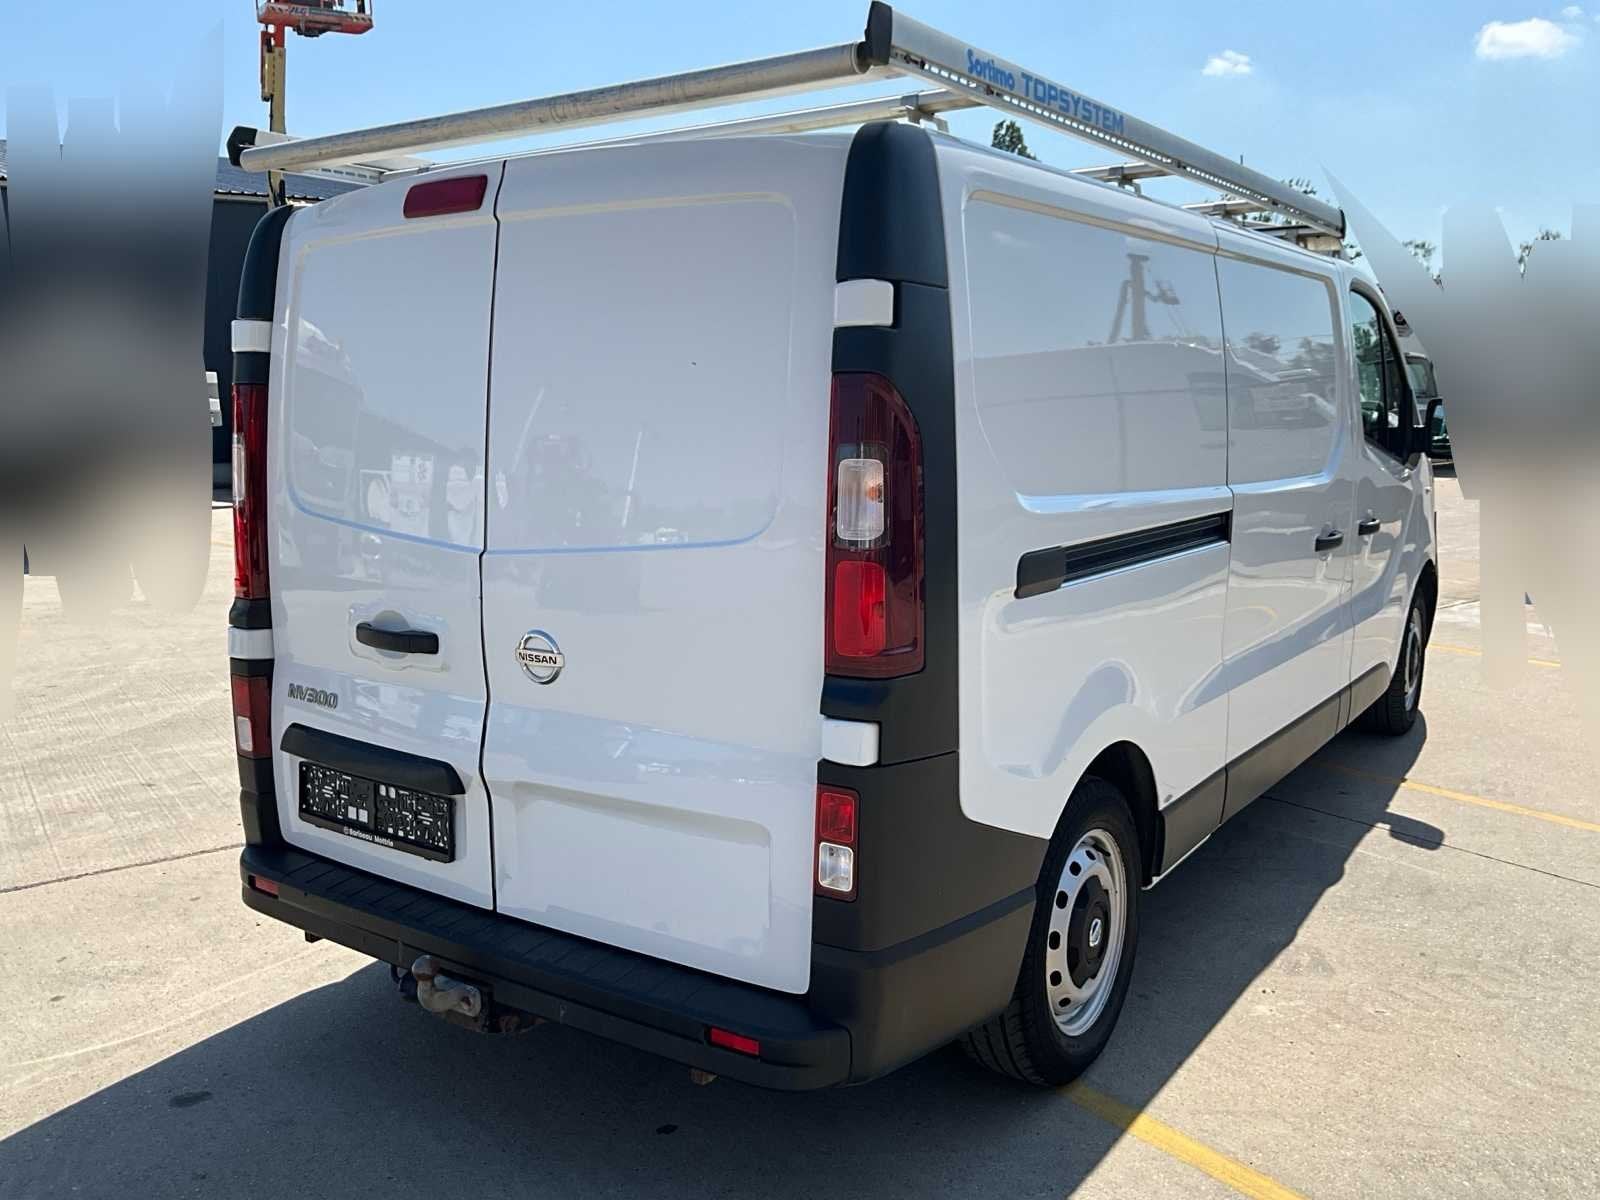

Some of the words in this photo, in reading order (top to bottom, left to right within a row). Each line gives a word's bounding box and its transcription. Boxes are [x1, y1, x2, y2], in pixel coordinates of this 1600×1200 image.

[967, 49, 1015, 91] Sortimo
[1021, 72, 1125, 135] TOPSYSTEM
[518, 652, 557, 665] NISSAN
[288, 683, 338, 710] NV300
